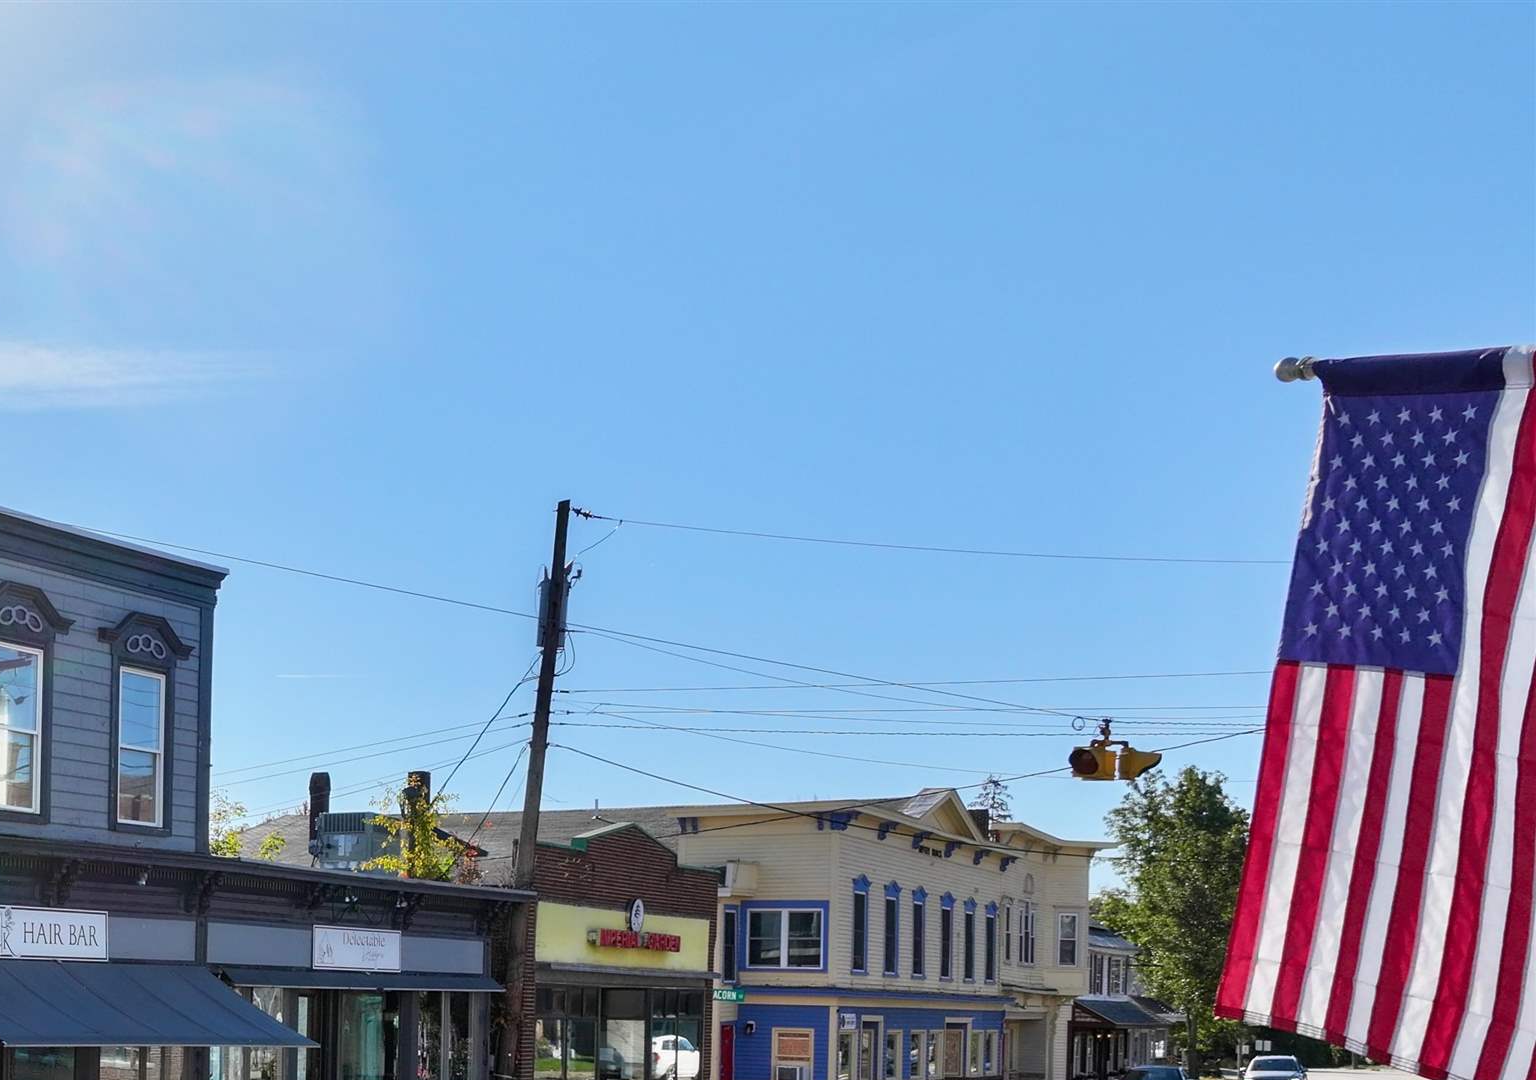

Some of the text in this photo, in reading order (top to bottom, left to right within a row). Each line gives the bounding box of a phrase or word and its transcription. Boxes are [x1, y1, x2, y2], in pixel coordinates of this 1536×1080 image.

[23, 922, 99, 946] HAIR BAR
[713, 990, 737, 1000] ACORN
